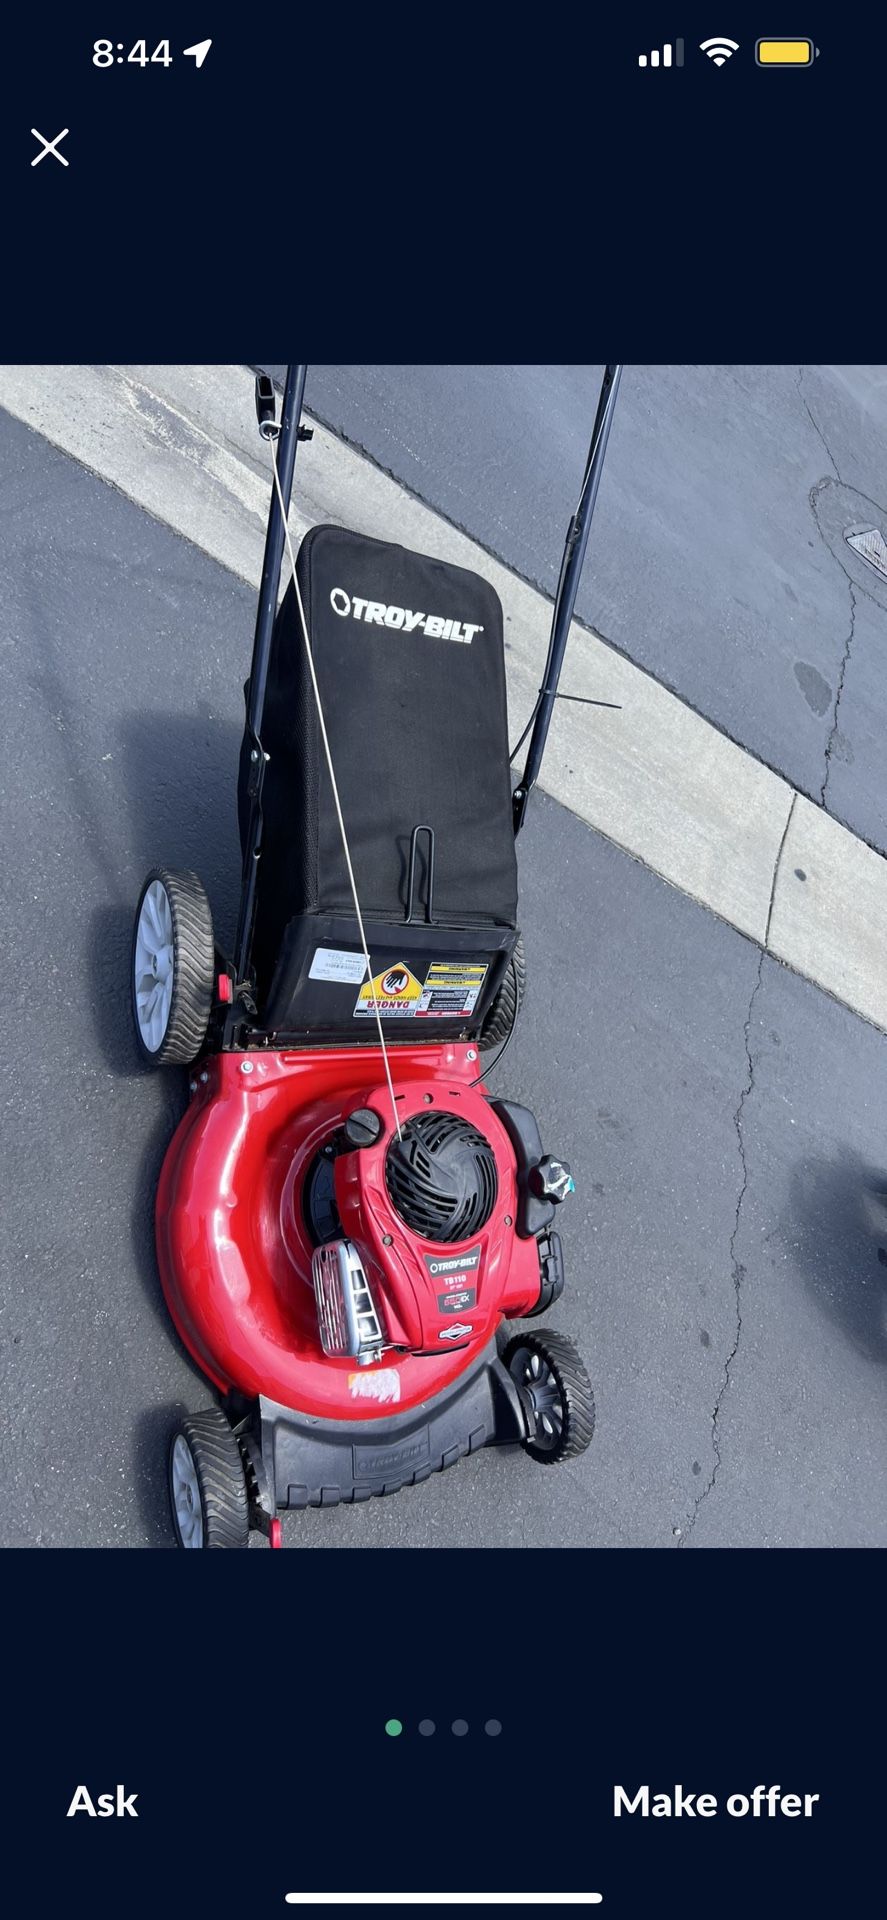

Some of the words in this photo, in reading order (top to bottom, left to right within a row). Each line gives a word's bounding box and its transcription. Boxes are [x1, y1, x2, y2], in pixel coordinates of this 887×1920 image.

[351, 596, 480, 645] TROY-BILT
[367, 1000, 409, 1008] DANGER
[437, 1256, 478, 1271] TROY-BILT
[444, 1275, 467, 1286] TB110
